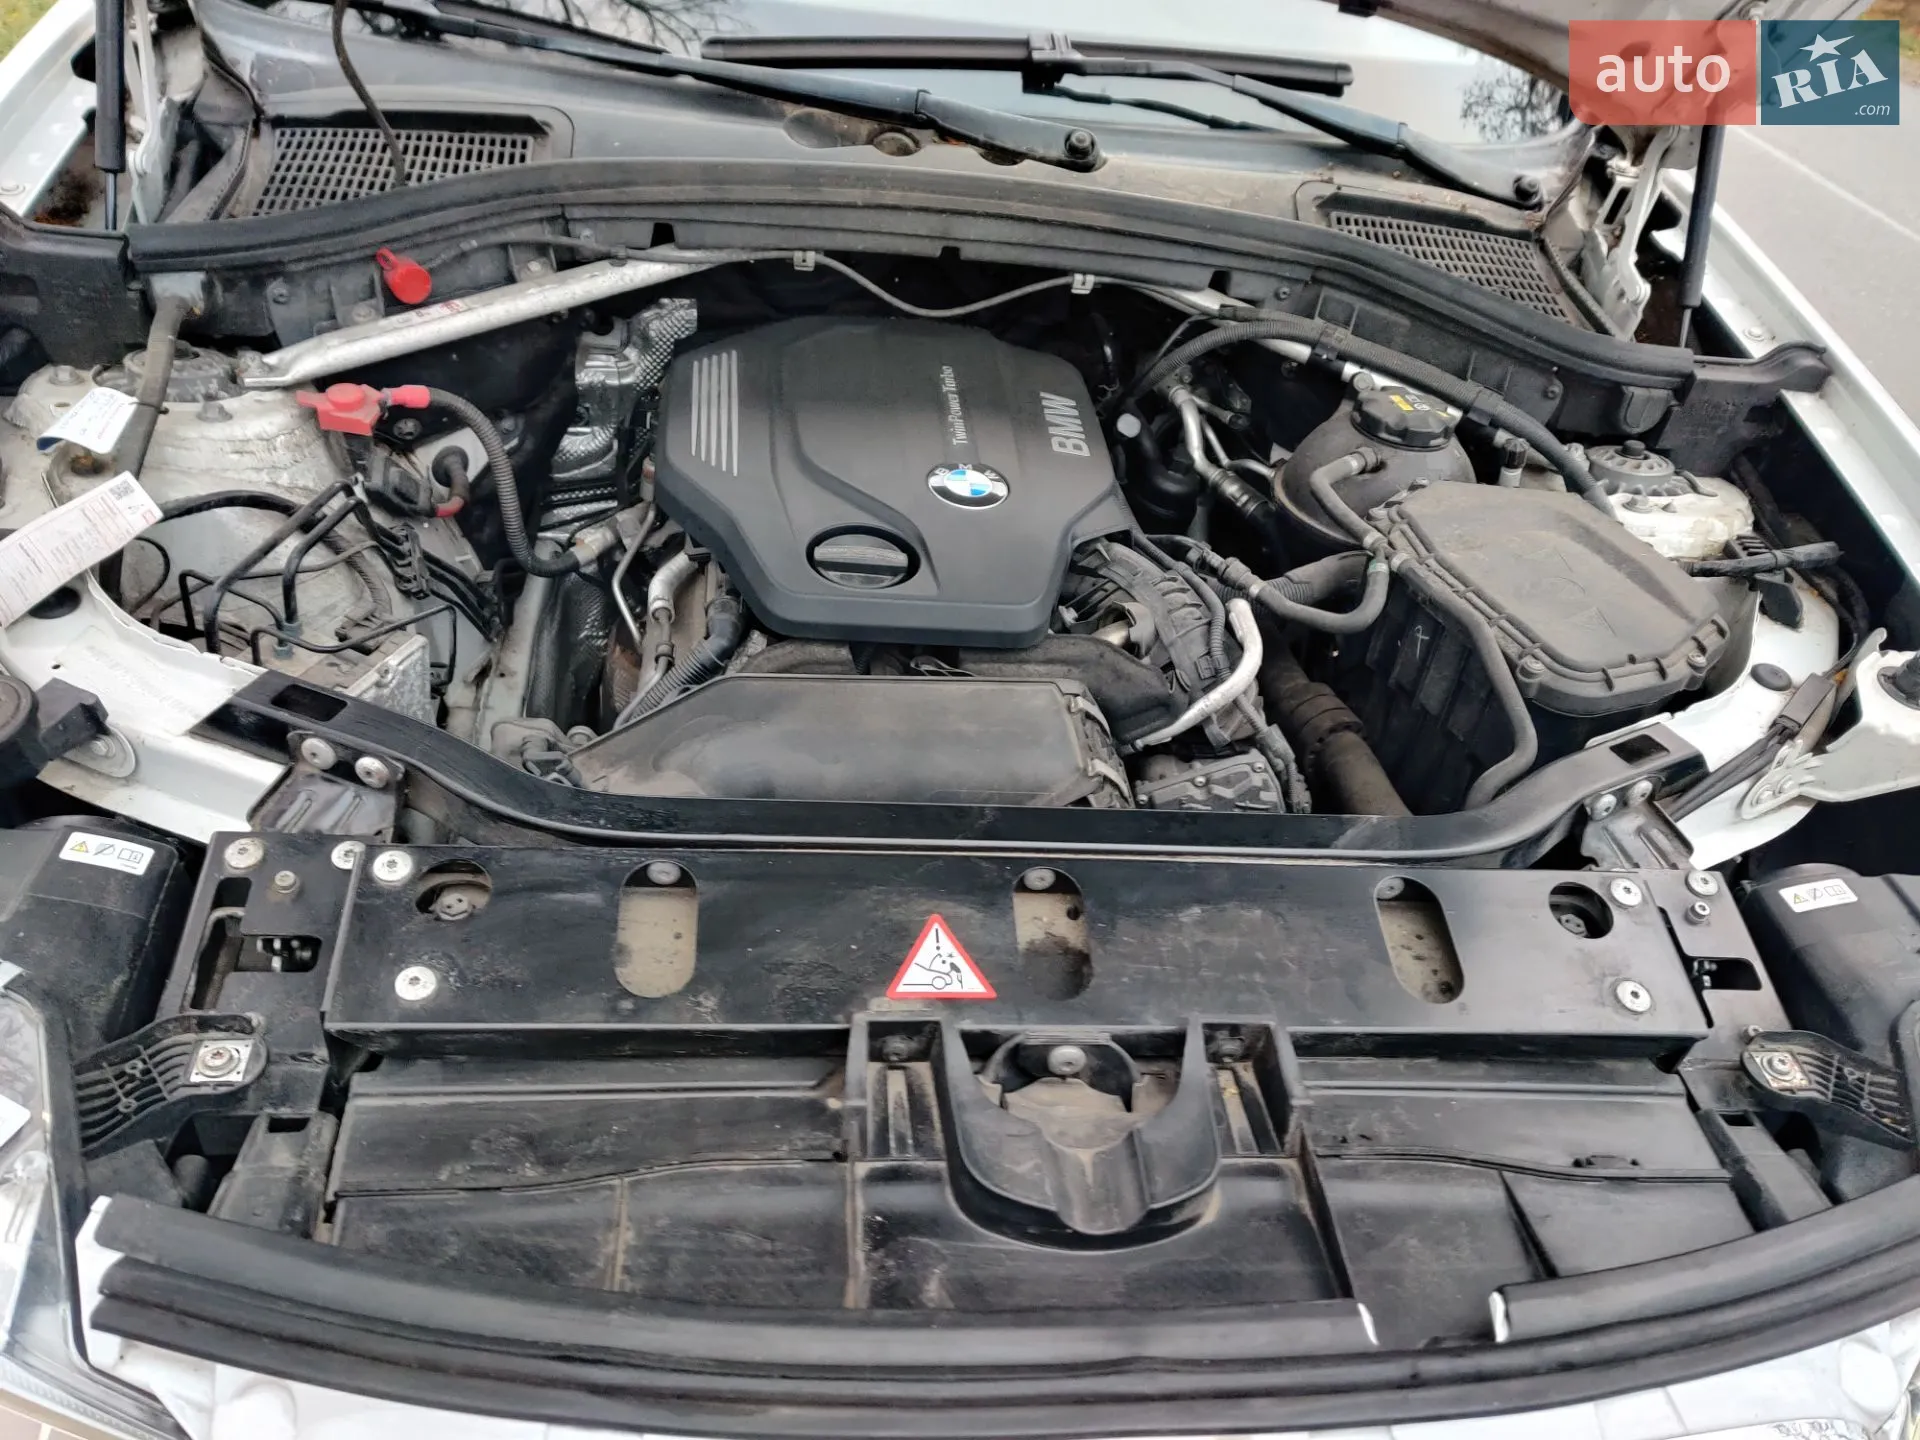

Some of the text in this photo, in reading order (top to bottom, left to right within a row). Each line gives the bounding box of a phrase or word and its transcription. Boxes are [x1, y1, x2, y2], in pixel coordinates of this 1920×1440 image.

[940, 365, 968, 445] TwinPower Turbo
[1039, 391, 1090, 457] BMW
